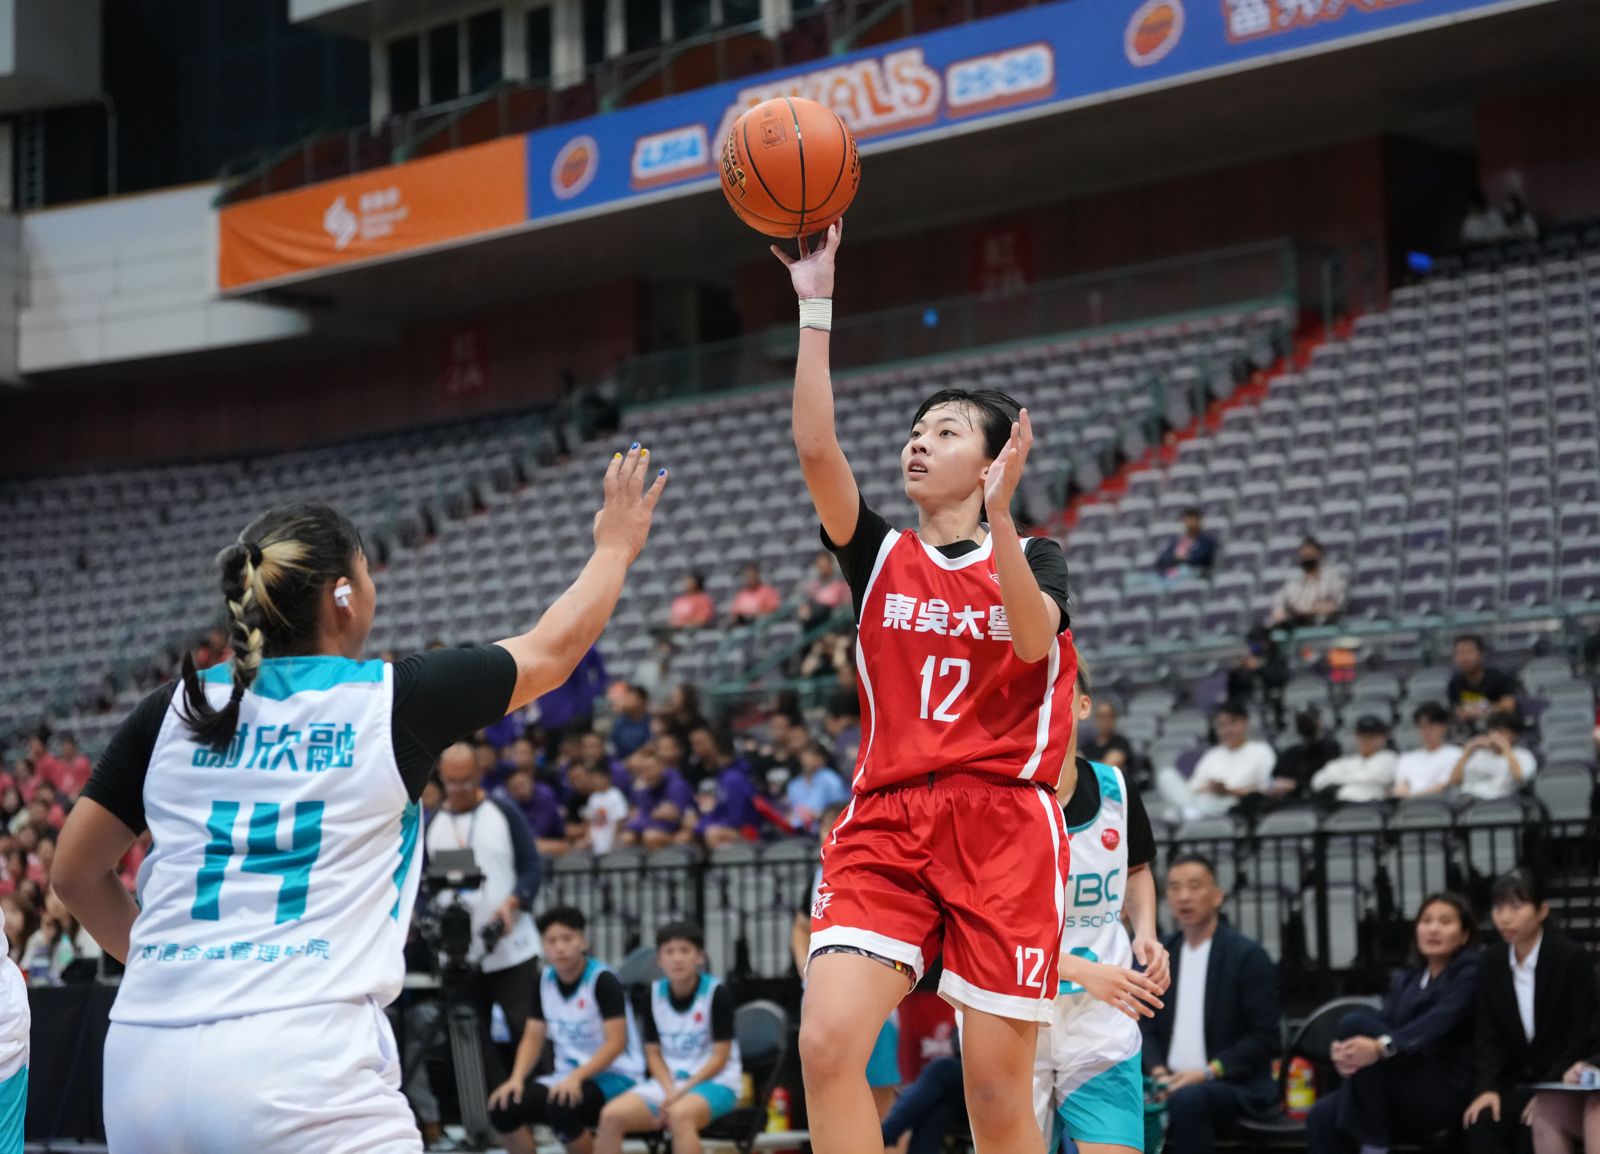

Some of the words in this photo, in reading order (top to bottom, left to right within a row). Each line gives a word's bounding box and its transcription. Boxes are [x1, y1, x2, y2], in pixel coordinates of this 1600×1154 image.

[920, 655, 970, 722] 12
[190, 800, 325, 925] 14
[1067, 868, 1120, 907] BC
[1015, 945, 1044, 988] 12
